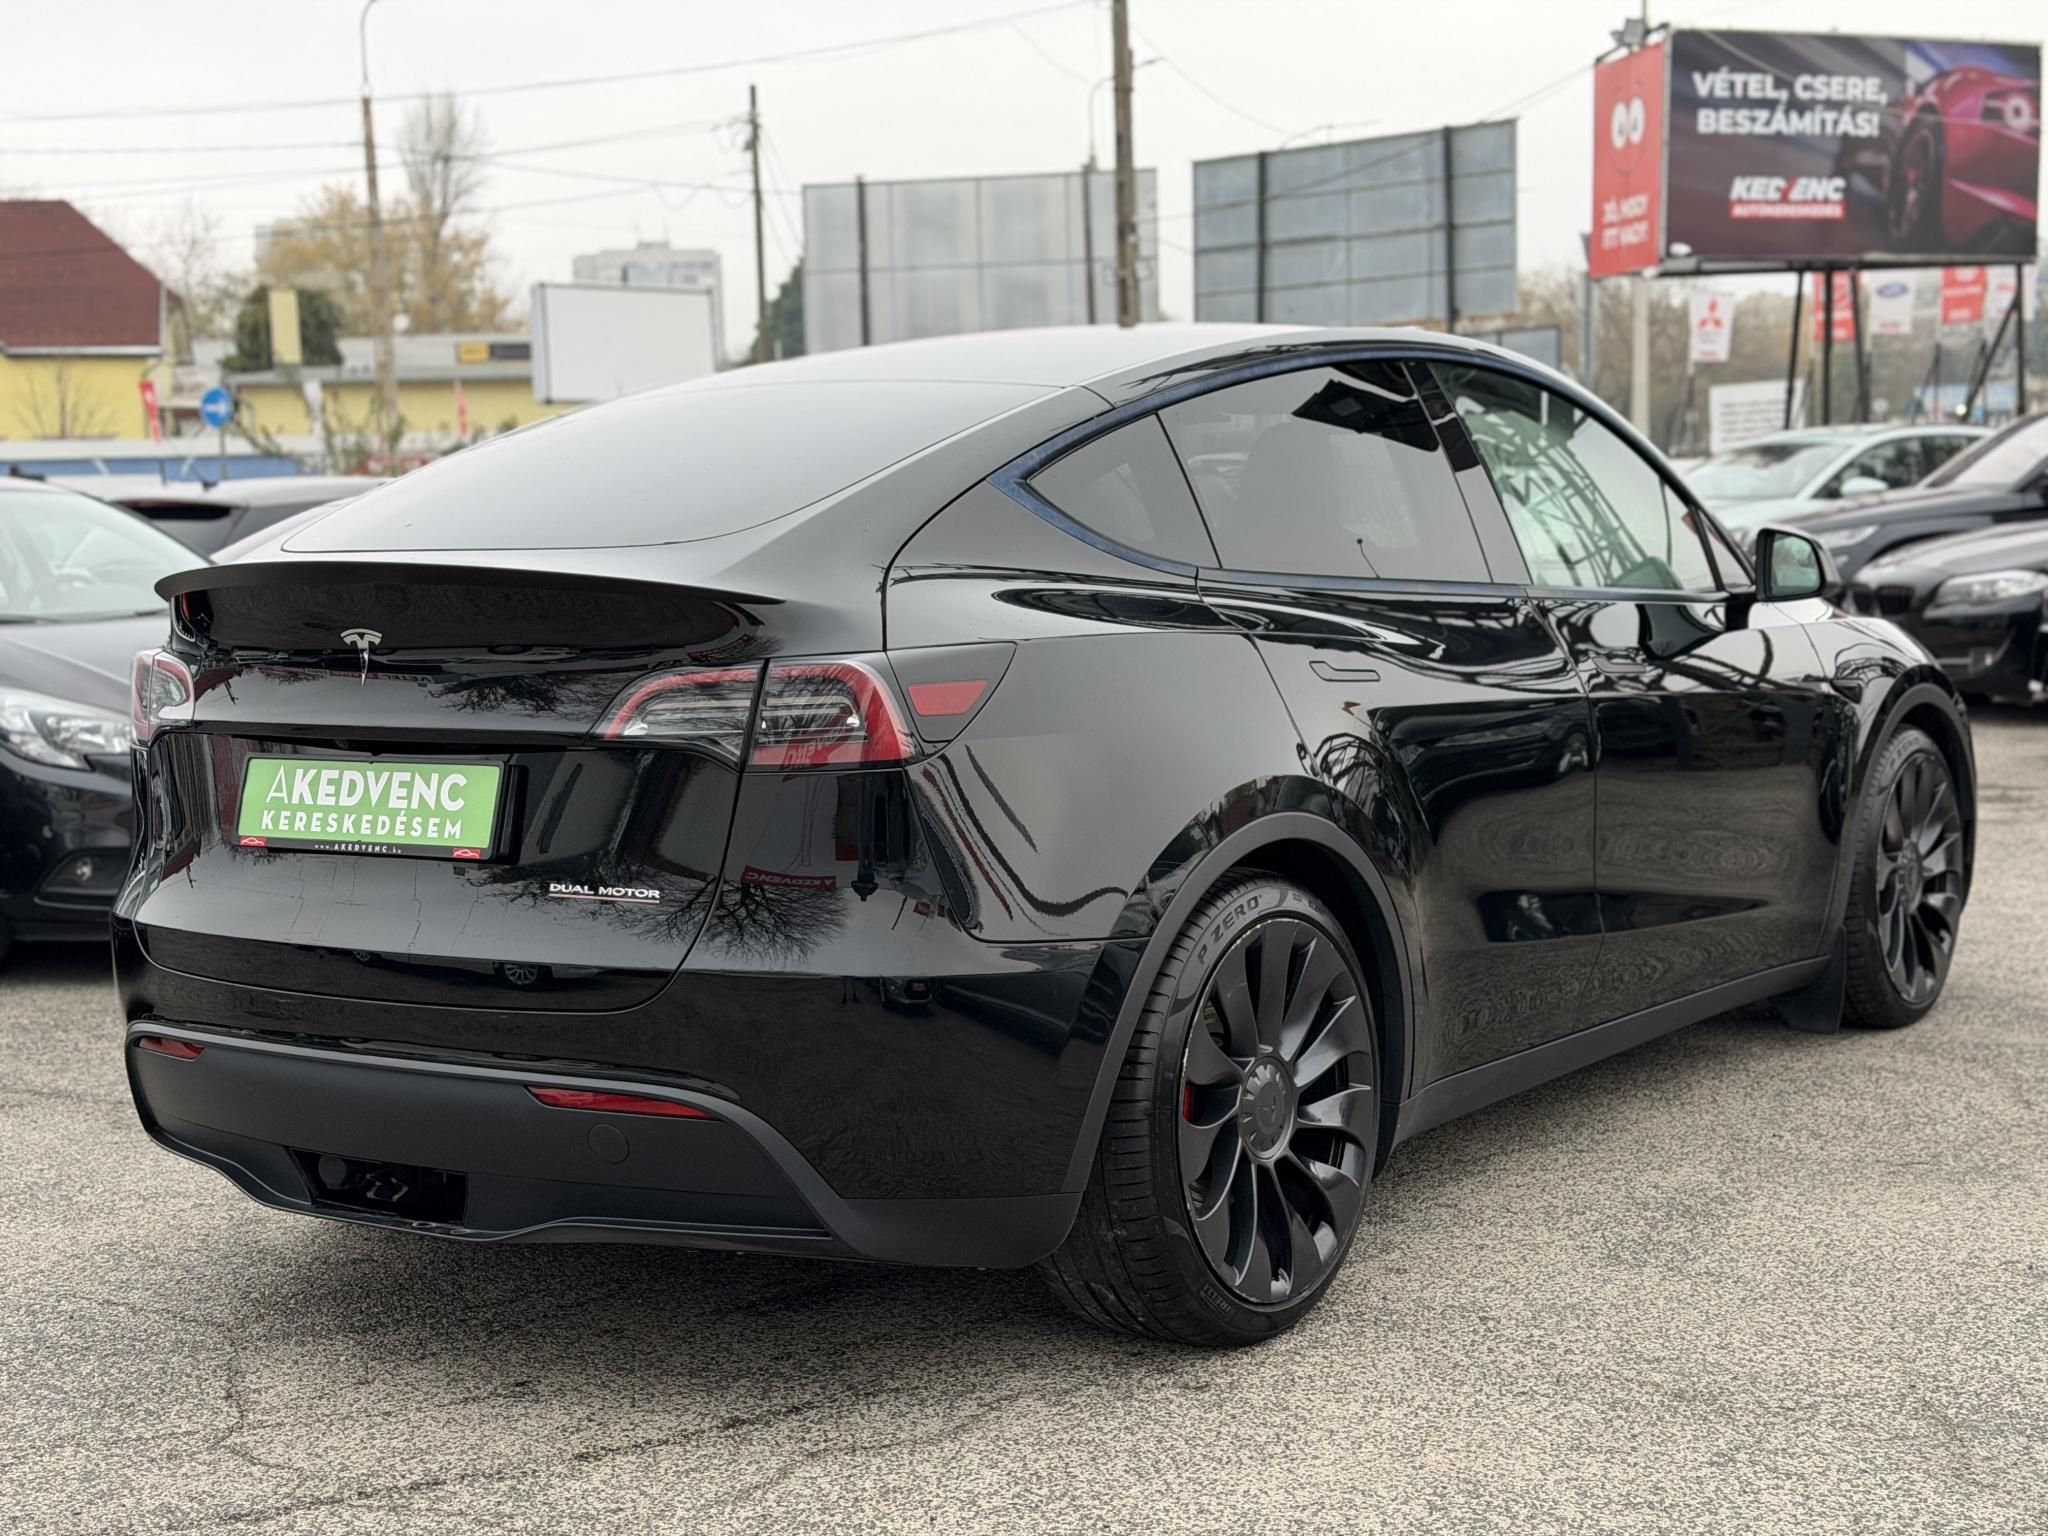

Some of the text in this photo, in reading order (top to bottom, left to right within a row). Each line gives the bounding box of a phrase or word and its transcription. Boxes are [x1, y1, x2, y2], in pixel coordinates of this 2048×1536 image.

[1691, 65, 1888, 106] VÉTEL, CSERE,
[1697, 103, 1881, 138] BESZÁMÍTÁS!
[262, 810, 462, 839] KERESKEDÉSEM
[549, 883, 660, 899] DUAL MOTOR
[1197, 894, 1260, 965] P ZERO
